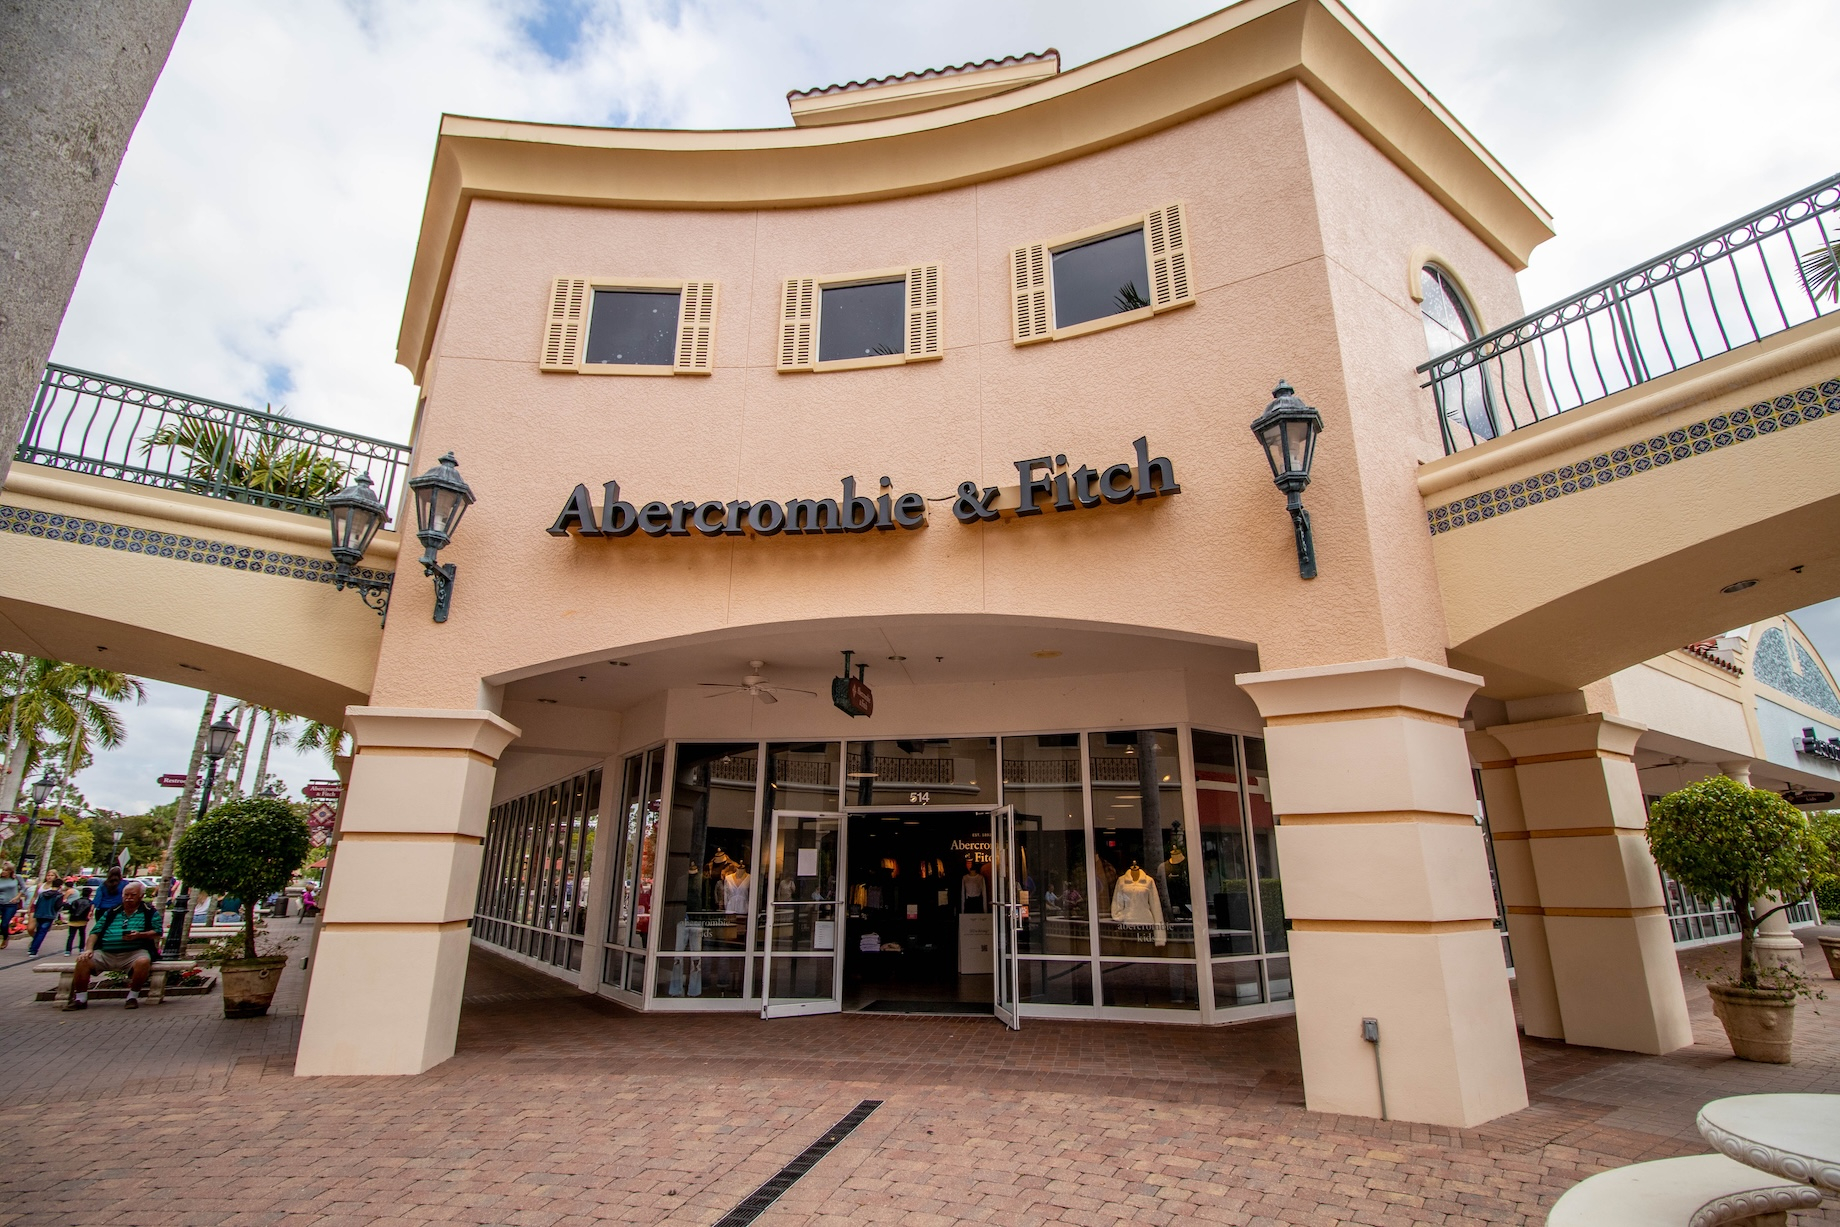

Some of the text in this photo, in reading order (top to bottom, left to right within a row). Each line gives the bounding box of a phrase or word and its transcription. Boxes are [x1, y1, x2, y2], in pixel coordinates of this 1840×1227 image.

[546, 436, 1181, 538] Abercrombie & Fitch
[909, 791, 930, 803] 514
[950, 839, 993, 851] Abercro
